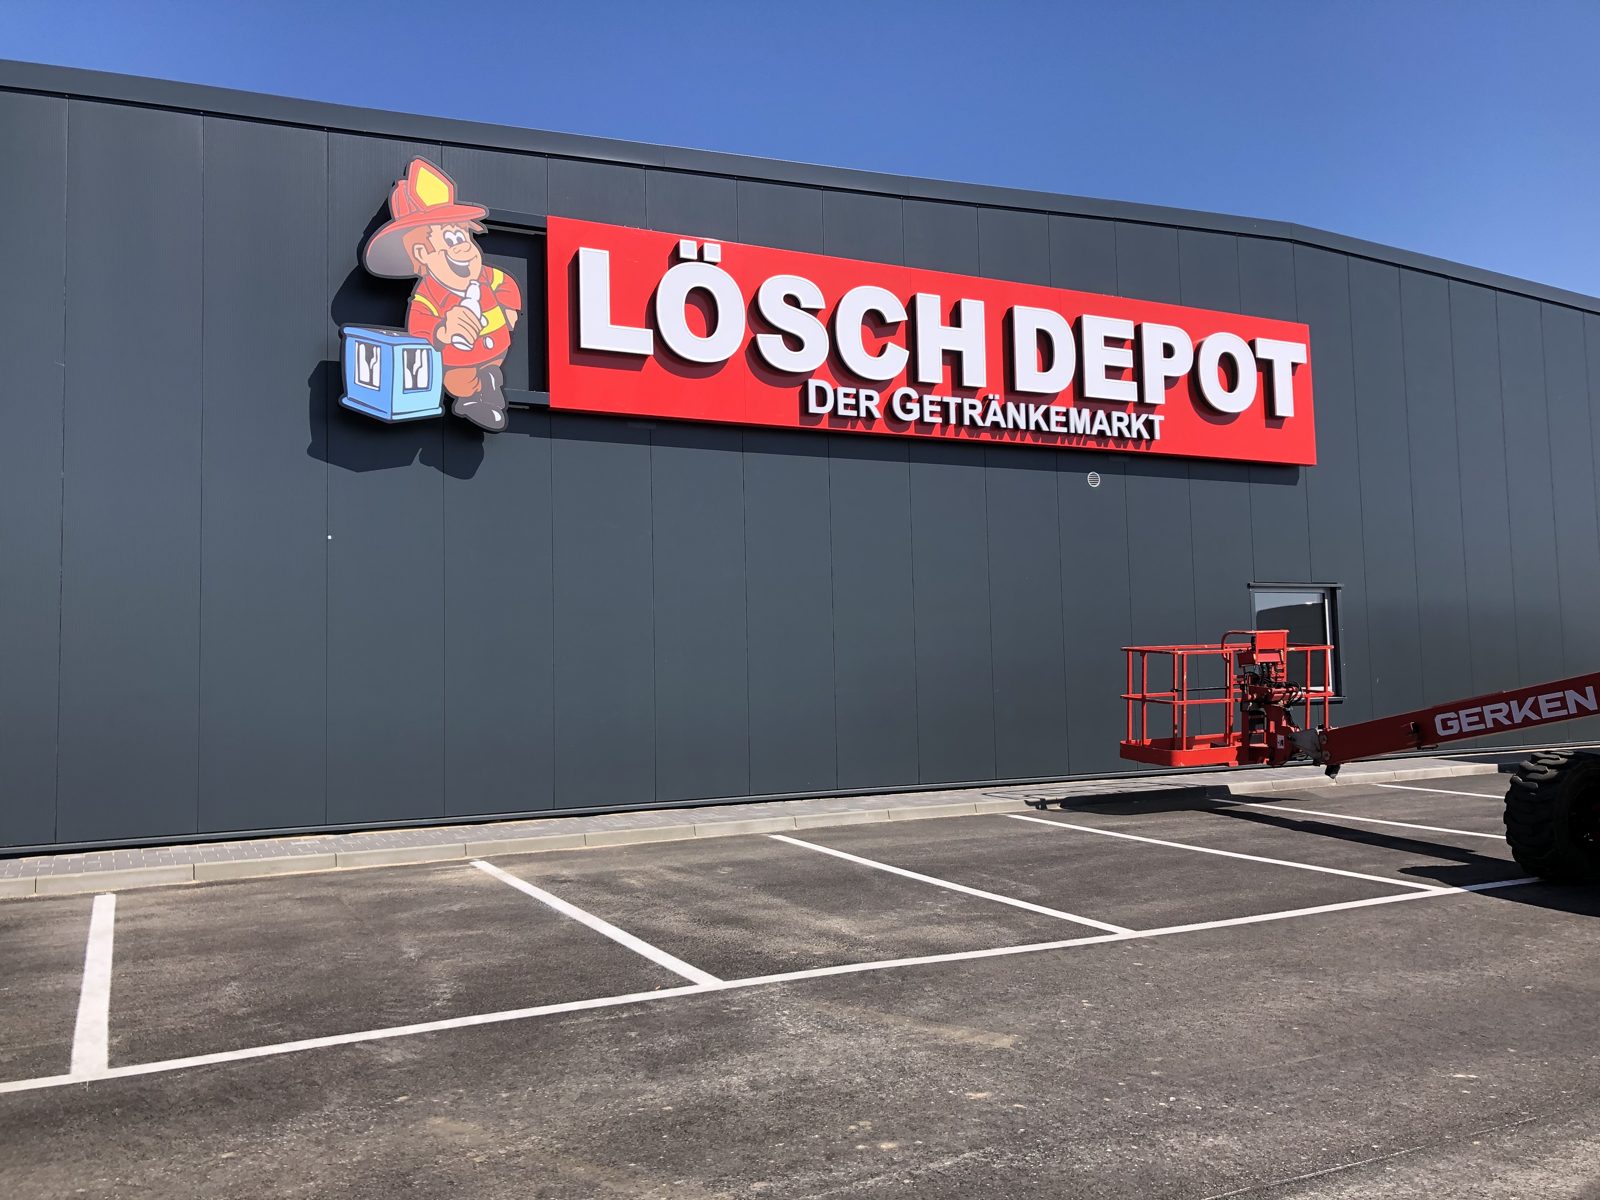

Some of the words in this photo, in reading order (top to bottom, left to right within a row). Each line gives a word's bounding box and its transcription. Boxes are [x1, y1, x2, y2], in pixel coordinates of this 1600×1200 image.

[579, 239, 987, 388] LÖSCH
[1013, 305, 1308, 418] DEPOT
[807, 379, 882, 420] DER
[892, 387, 1165, 440] GETRÄNKEMARKT
[1434, 686, 1599, 737] GERKEN
